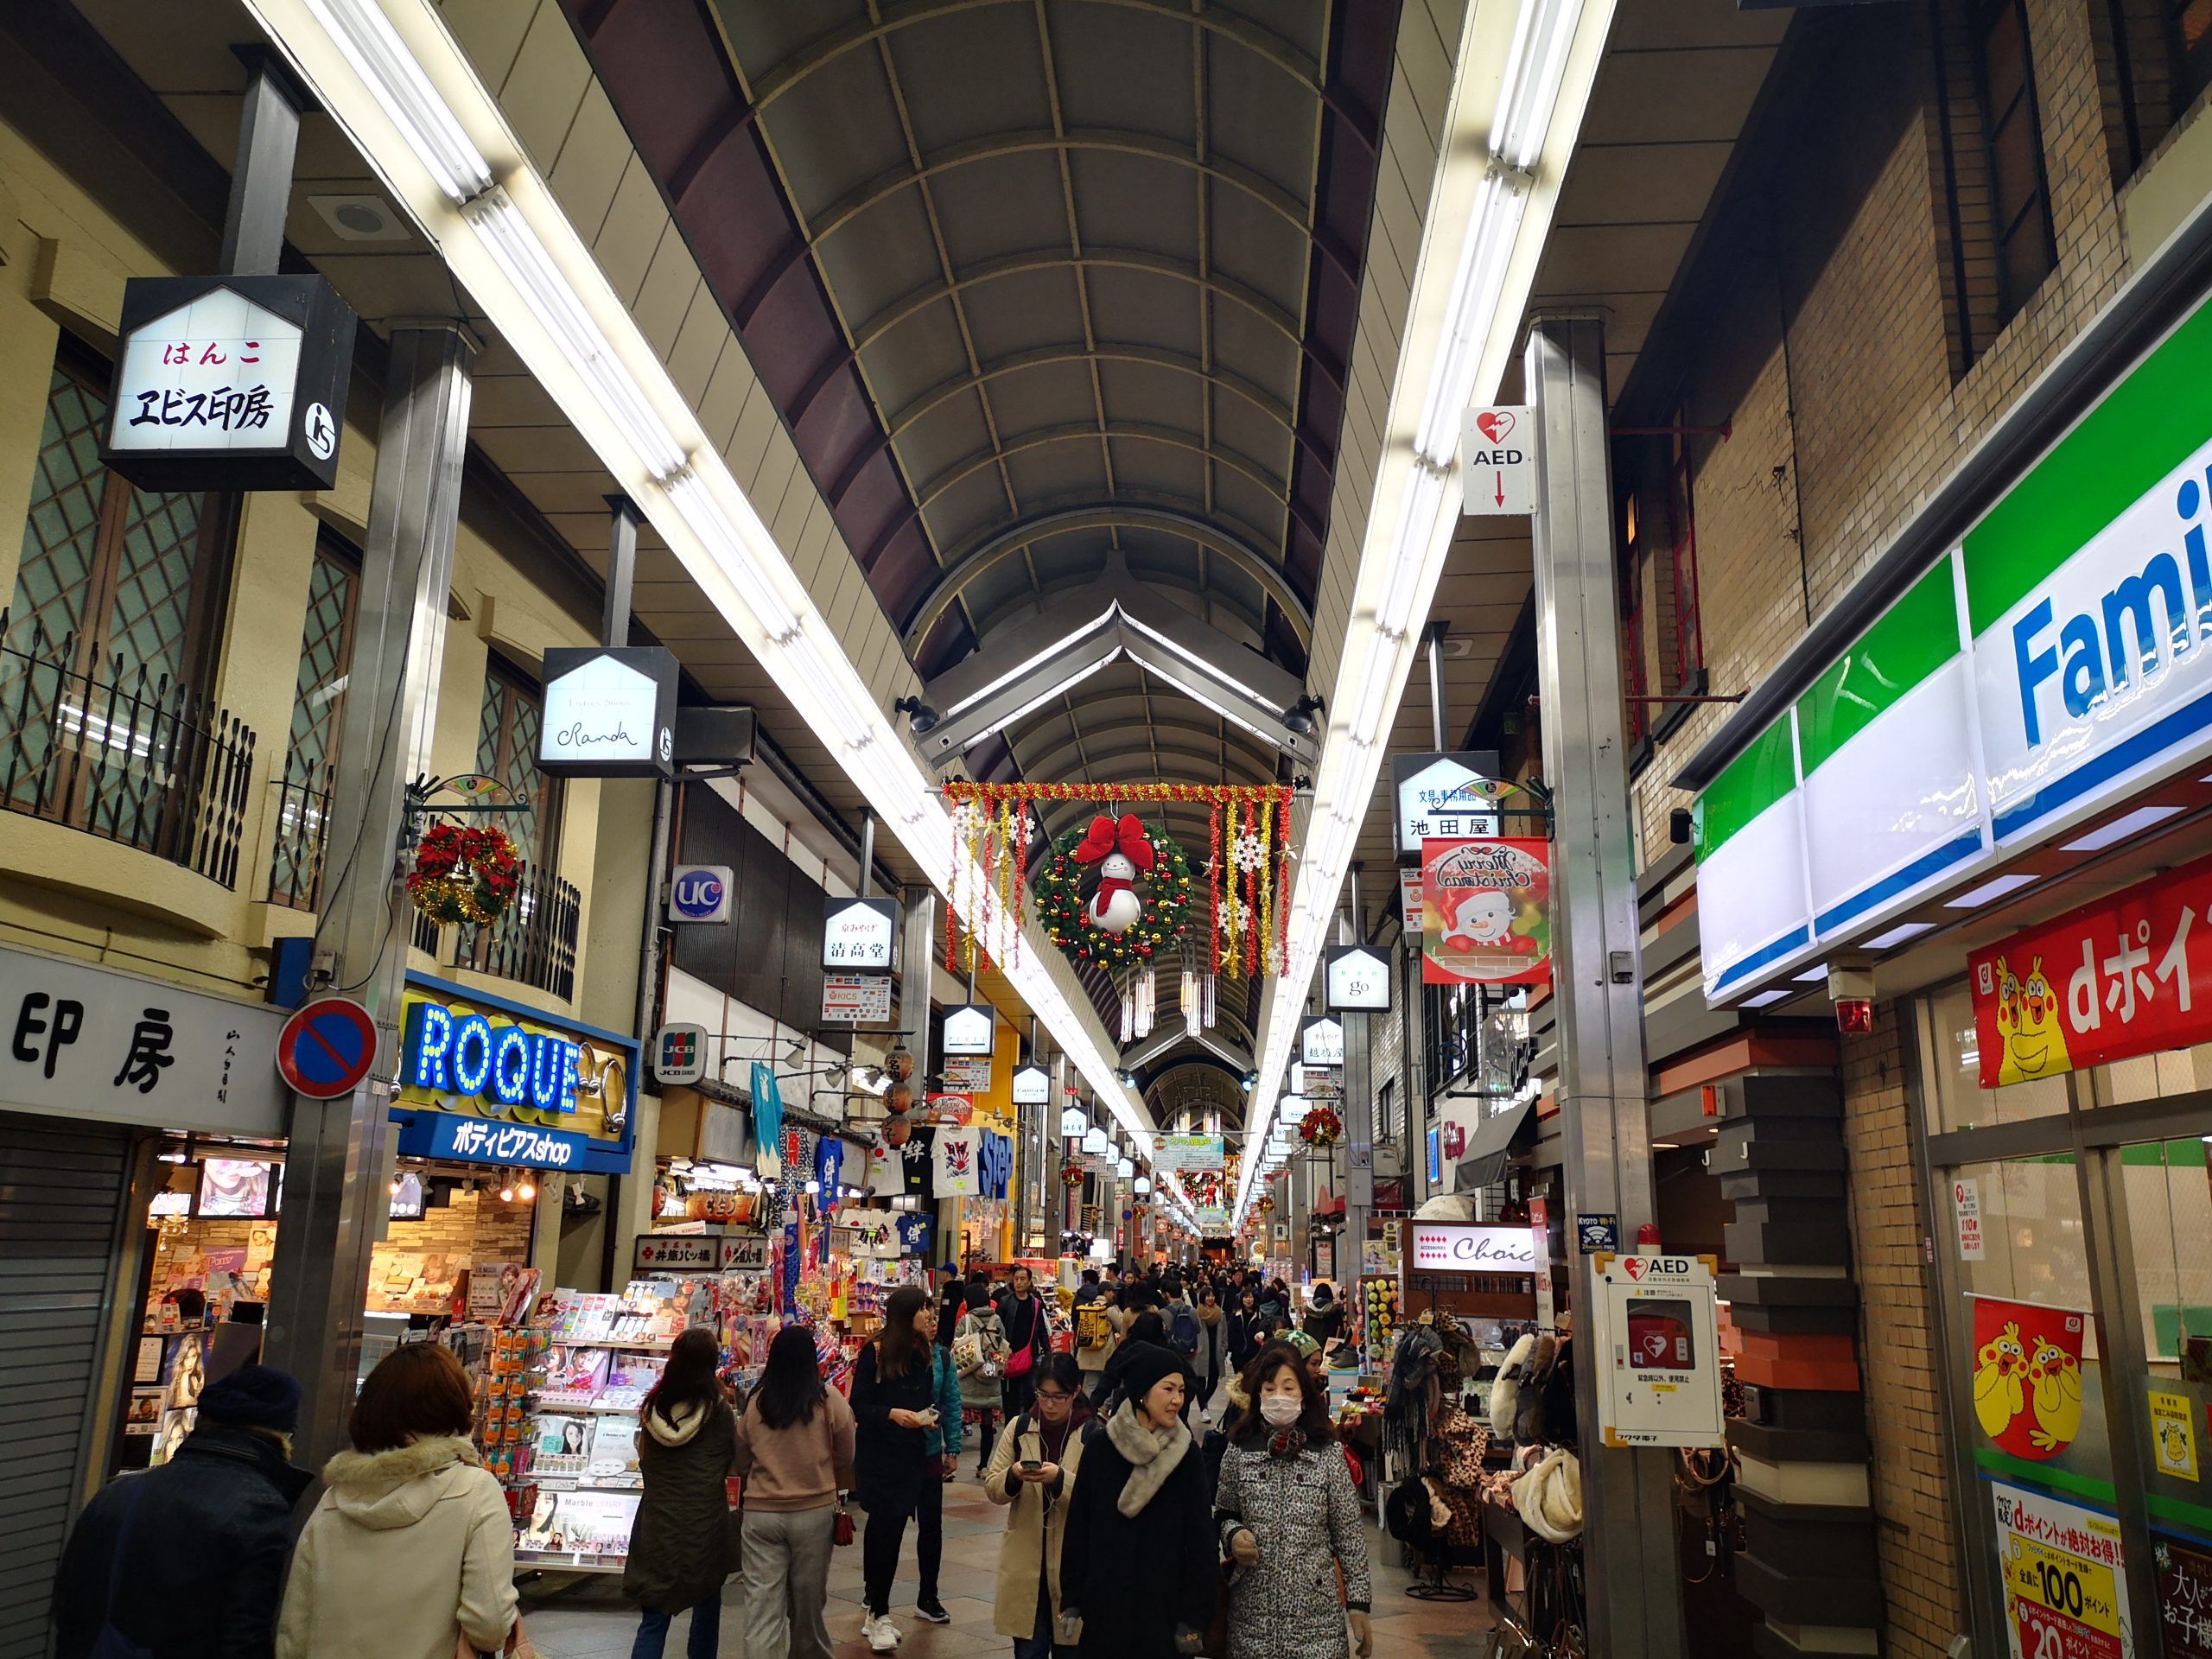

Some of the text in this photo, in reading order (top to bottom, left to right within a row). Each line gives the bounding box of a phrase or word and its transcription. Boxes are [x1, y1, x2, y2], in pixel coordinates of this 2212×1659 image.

[163, 341, 260, 365] はんこ
[129, 384, 274, 431] ヱビス印房
[1472, 449, 1523, 466] AED
[2012, 463, 2212, 752] Fami
[1410, 818, 1490, 836] 池田屋
[678, 880, 721, 906] UC
[2068, 905, 2212, 1034] dポイ
[1349, 981, 1370, 996] go
[12, 992, 175, 1094] 印房
[416, 1002, 582, 1114] ROQUE
[904, 1140, 925, 1164] 絆
[982, 1128, 1014, 1199] Step
[1453, 1237, 1535, 1262] Choic
[1649, 1259, 1689, 1274] AED
[564, 1498, 594, 1507] Marble
[2036, 1560, 2083, 1618] 100
[2084, 1595, 2110, 1618] ポイント
[2171, 1564, 2212, 1610] 大人が
